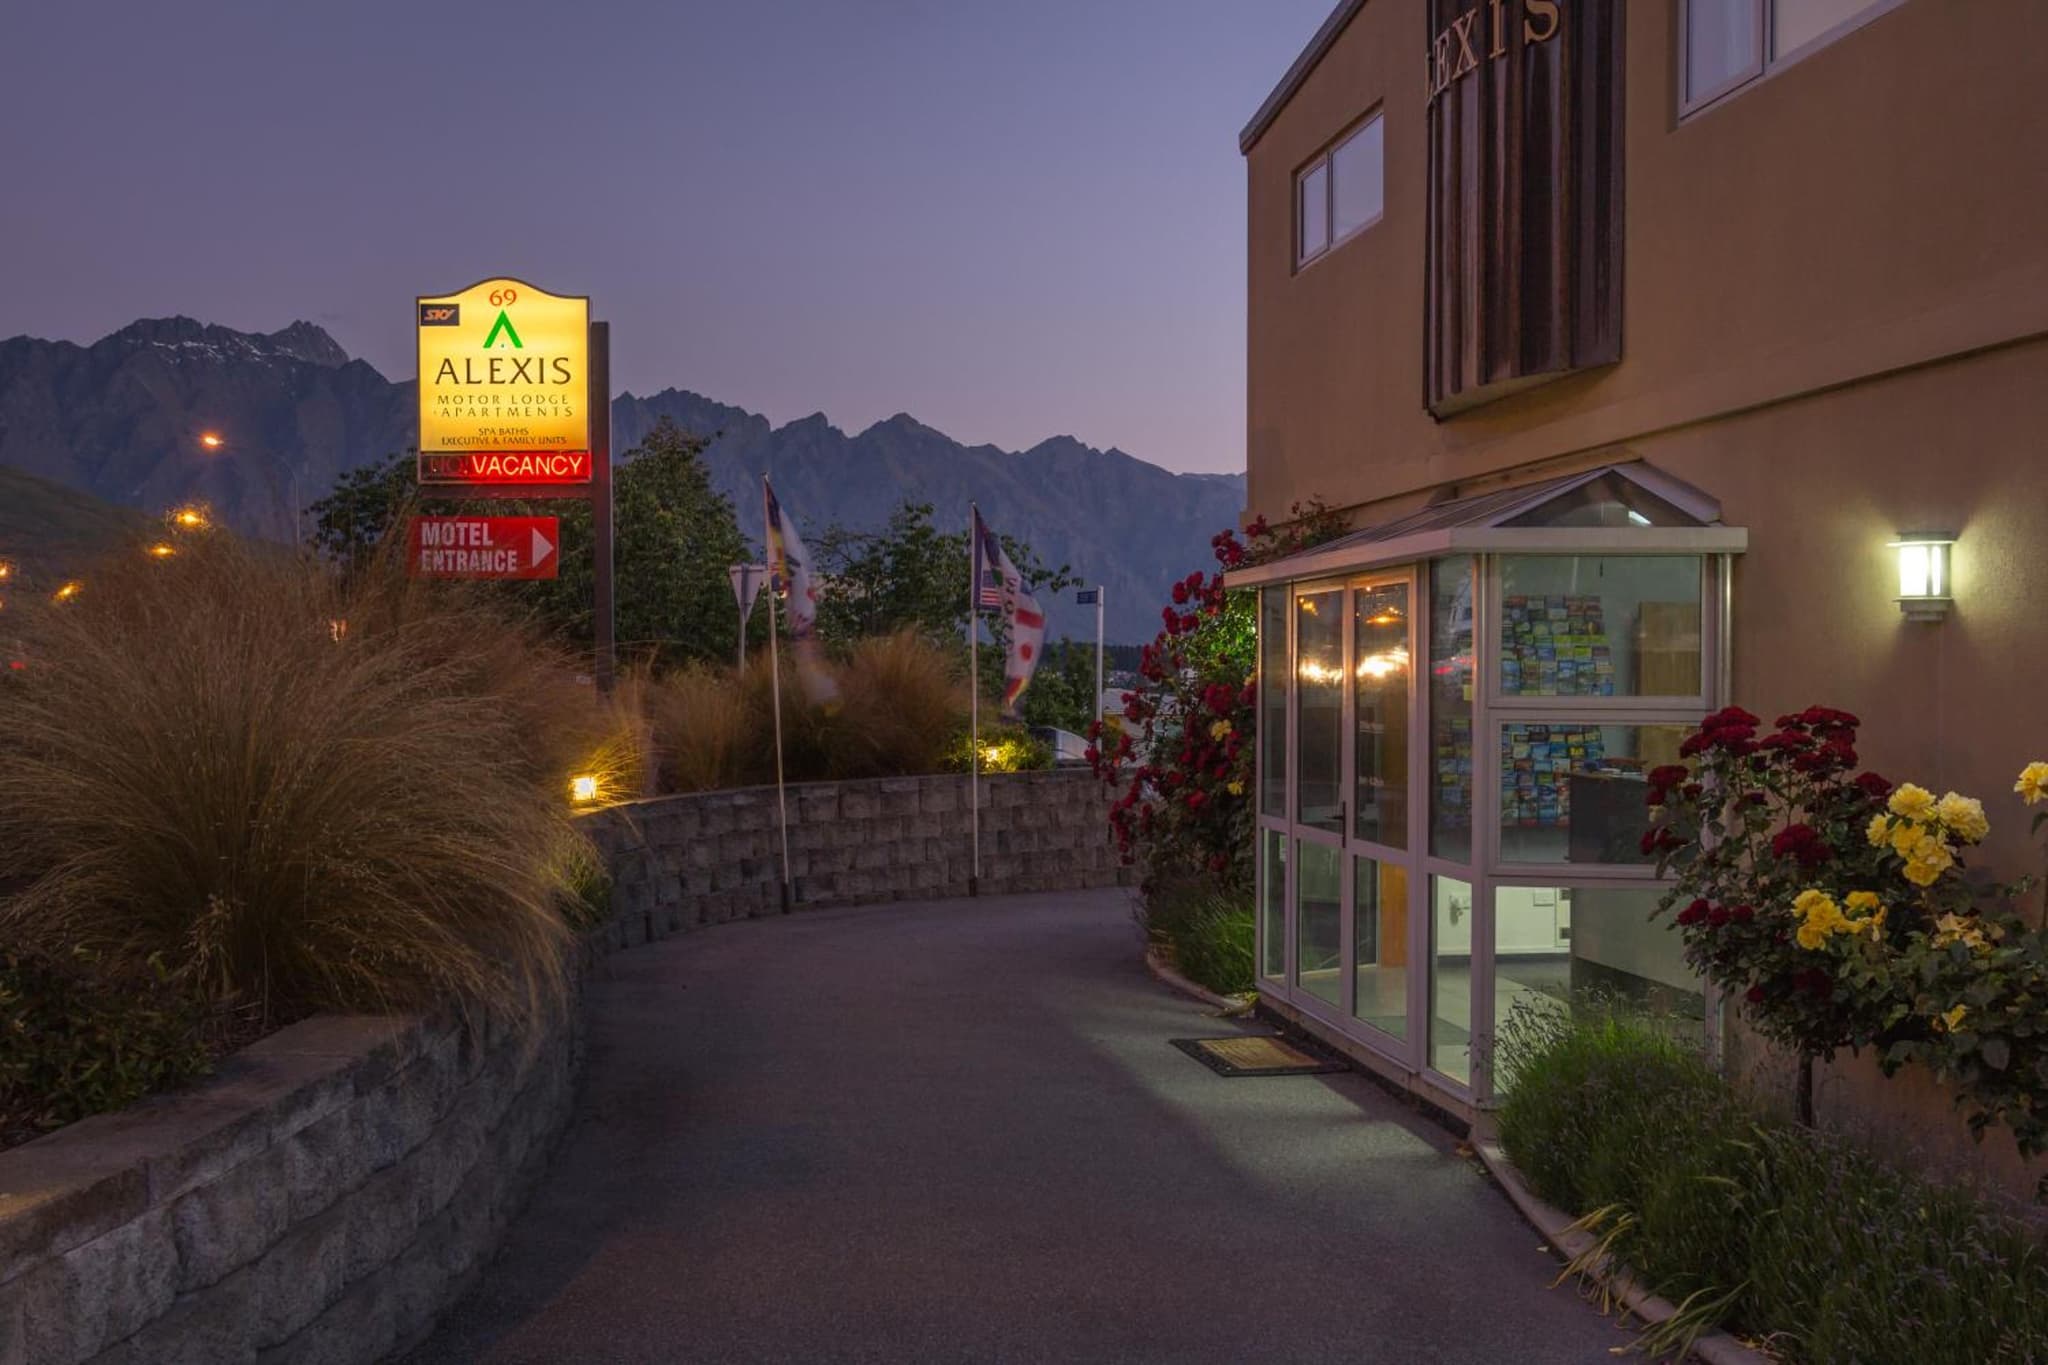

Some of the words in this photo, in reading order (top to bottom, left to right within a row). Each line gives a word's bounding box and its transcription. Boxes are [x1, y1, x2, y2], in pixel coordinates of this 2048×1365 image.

[489, 289, 517, 307] 69
[435, 357, 571, 385] ALEXIS
[437, 395, 500, 405] MOTOR
[511, 395, 568, 405] LODGE
[441, 406, 573, 417] APARTMENTS
[441, 436, 490, 446] EXECUTIVE
[492, 437, 500, 445] &
[503, 437, 535, 446] FAMILY
[538, 436, 567, 445] UNITS
[478, 428, 495, 436] SPA
[499, 428, 529, 436] BATHS
[472, 456, 583, 476] VACANCY
[421, 522, 493, 546] MOTEL
[421, 550, 518, 572] ENTRANCE
